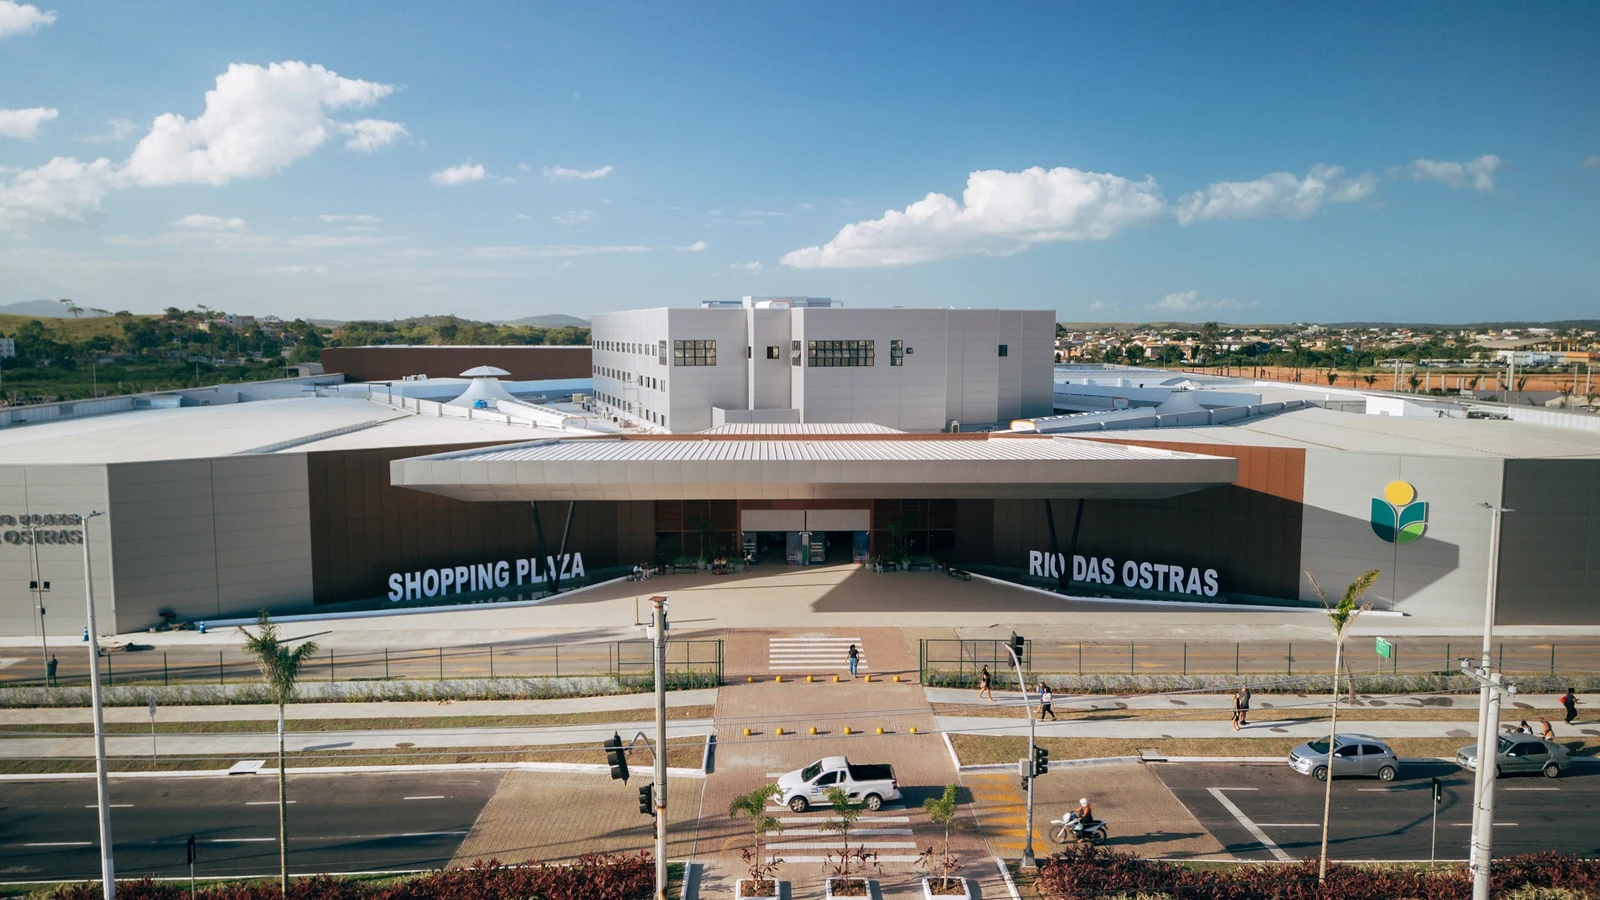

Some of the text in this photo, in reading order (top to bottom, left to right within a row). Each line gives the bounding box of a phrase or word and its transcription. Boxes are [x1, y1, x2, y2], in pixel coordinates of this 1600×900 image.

[18, 513, 82, 526] PLAZA
[388, 552, 585, 602] SHOPPING PLAZA
[1029, 550, 1219, 597] RIO DAS OSTRAS
